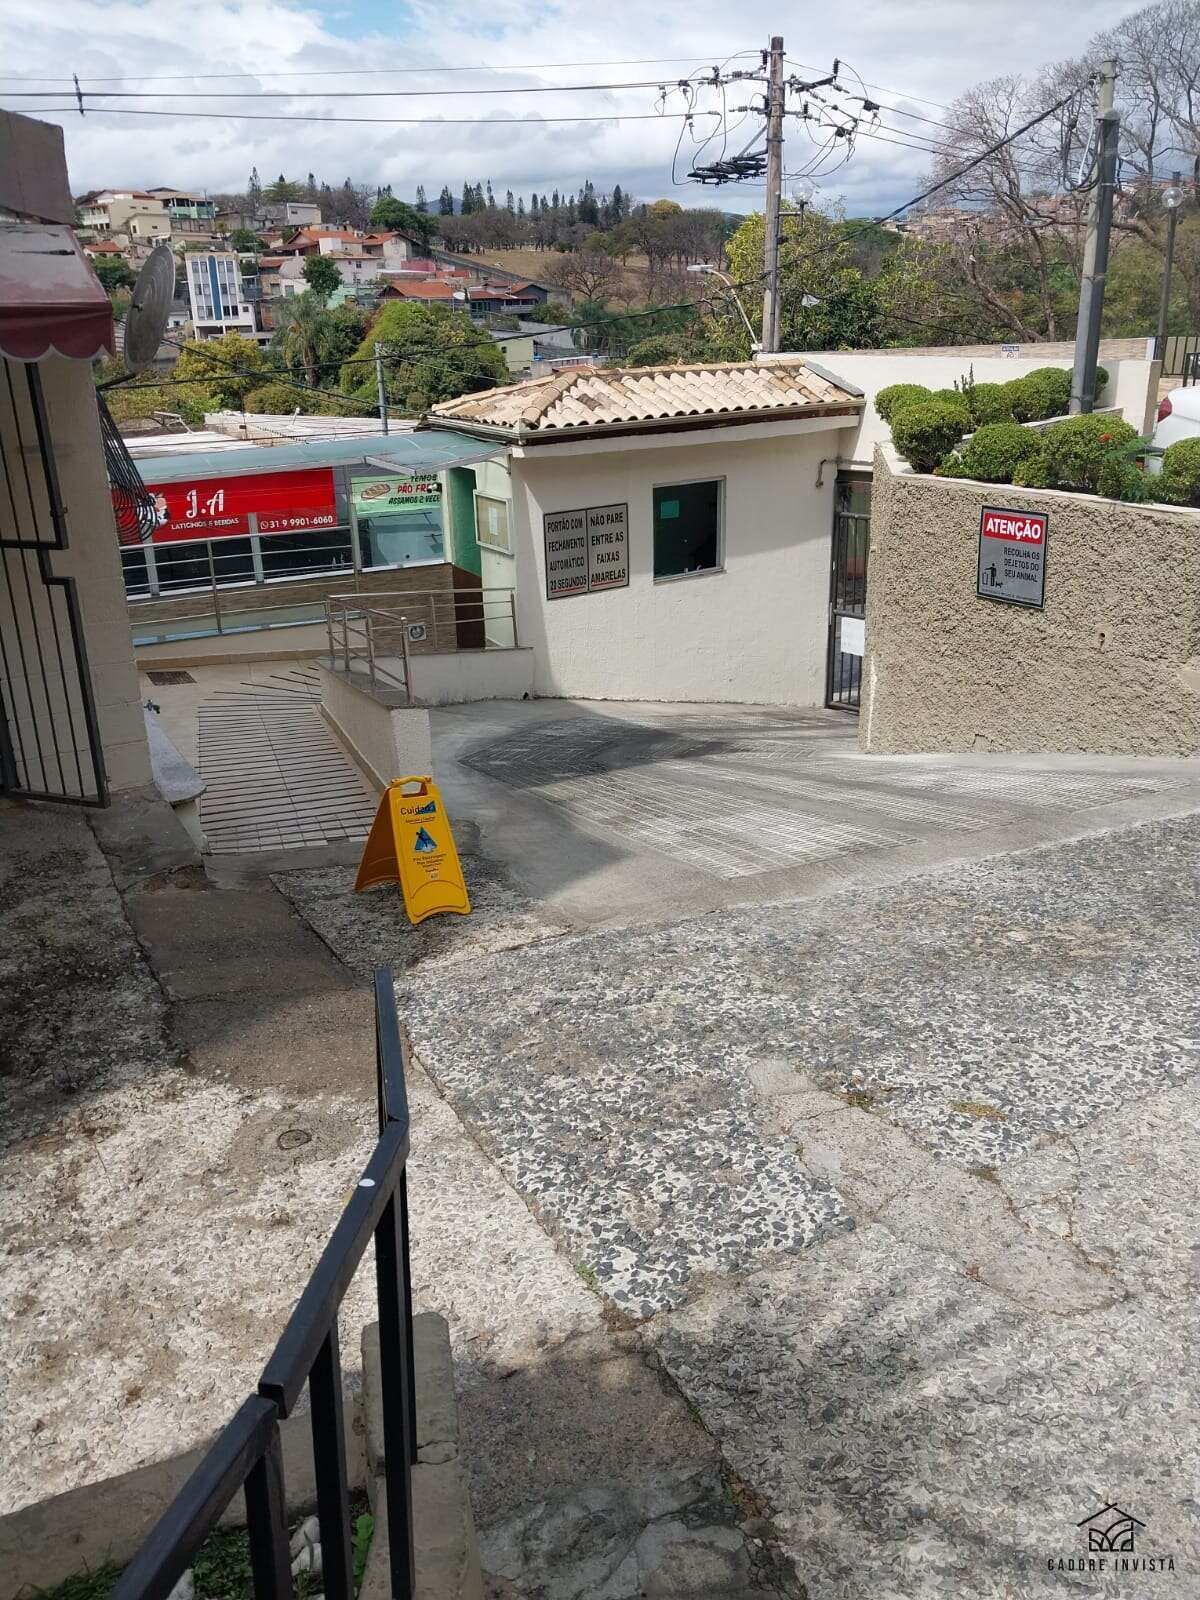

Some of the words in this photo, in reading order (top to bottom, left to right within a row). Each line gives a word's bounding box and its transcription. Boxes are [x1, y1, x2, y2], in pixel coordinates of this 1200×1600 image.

[411, 474, 437, 482] TEMOS
[398, 483, 412, 493] PÃO
[186, 489, 224, 519] J.A
[388, 496, 417, 505] ASSAMOS
[419, 496, 424, 504] 2
[214, 518, 239, 526] BEBIDAS
[269, 520, 279, 529] 31
[282, 519, 287, 527] 9
[289, 515, 333, 527] 9901-6060
[547, 518, 570, 533] PORTÃO
[570, 517, 583, 530] COM
[590, 513, 605, 527] NÃO
[606, 512, 624, 525] PARE
[986, 517, 1041, 540] ATENÇÃO
[548, 537, 585, 553] FECHAMENTO
[591, 533, 613, 546] ENTRE
[614, 531, 624, 543] AS
[596, 551, 620, 565] FAIXAS
[1003, 547, 1030, 558] RECOLHA
[1031, 551, 1040, 560] OS
[1003, 558, 1030, 570] DEJETOS
[1030, 562, 1040, 571] DO
[558, 574, 587, 589] SEGUNDOS
[591, 568, 626, 583] AMARELAS
[1004, 569, 1016, 577] SEU
[1016, 571, 1038, 582] ANIMAL
